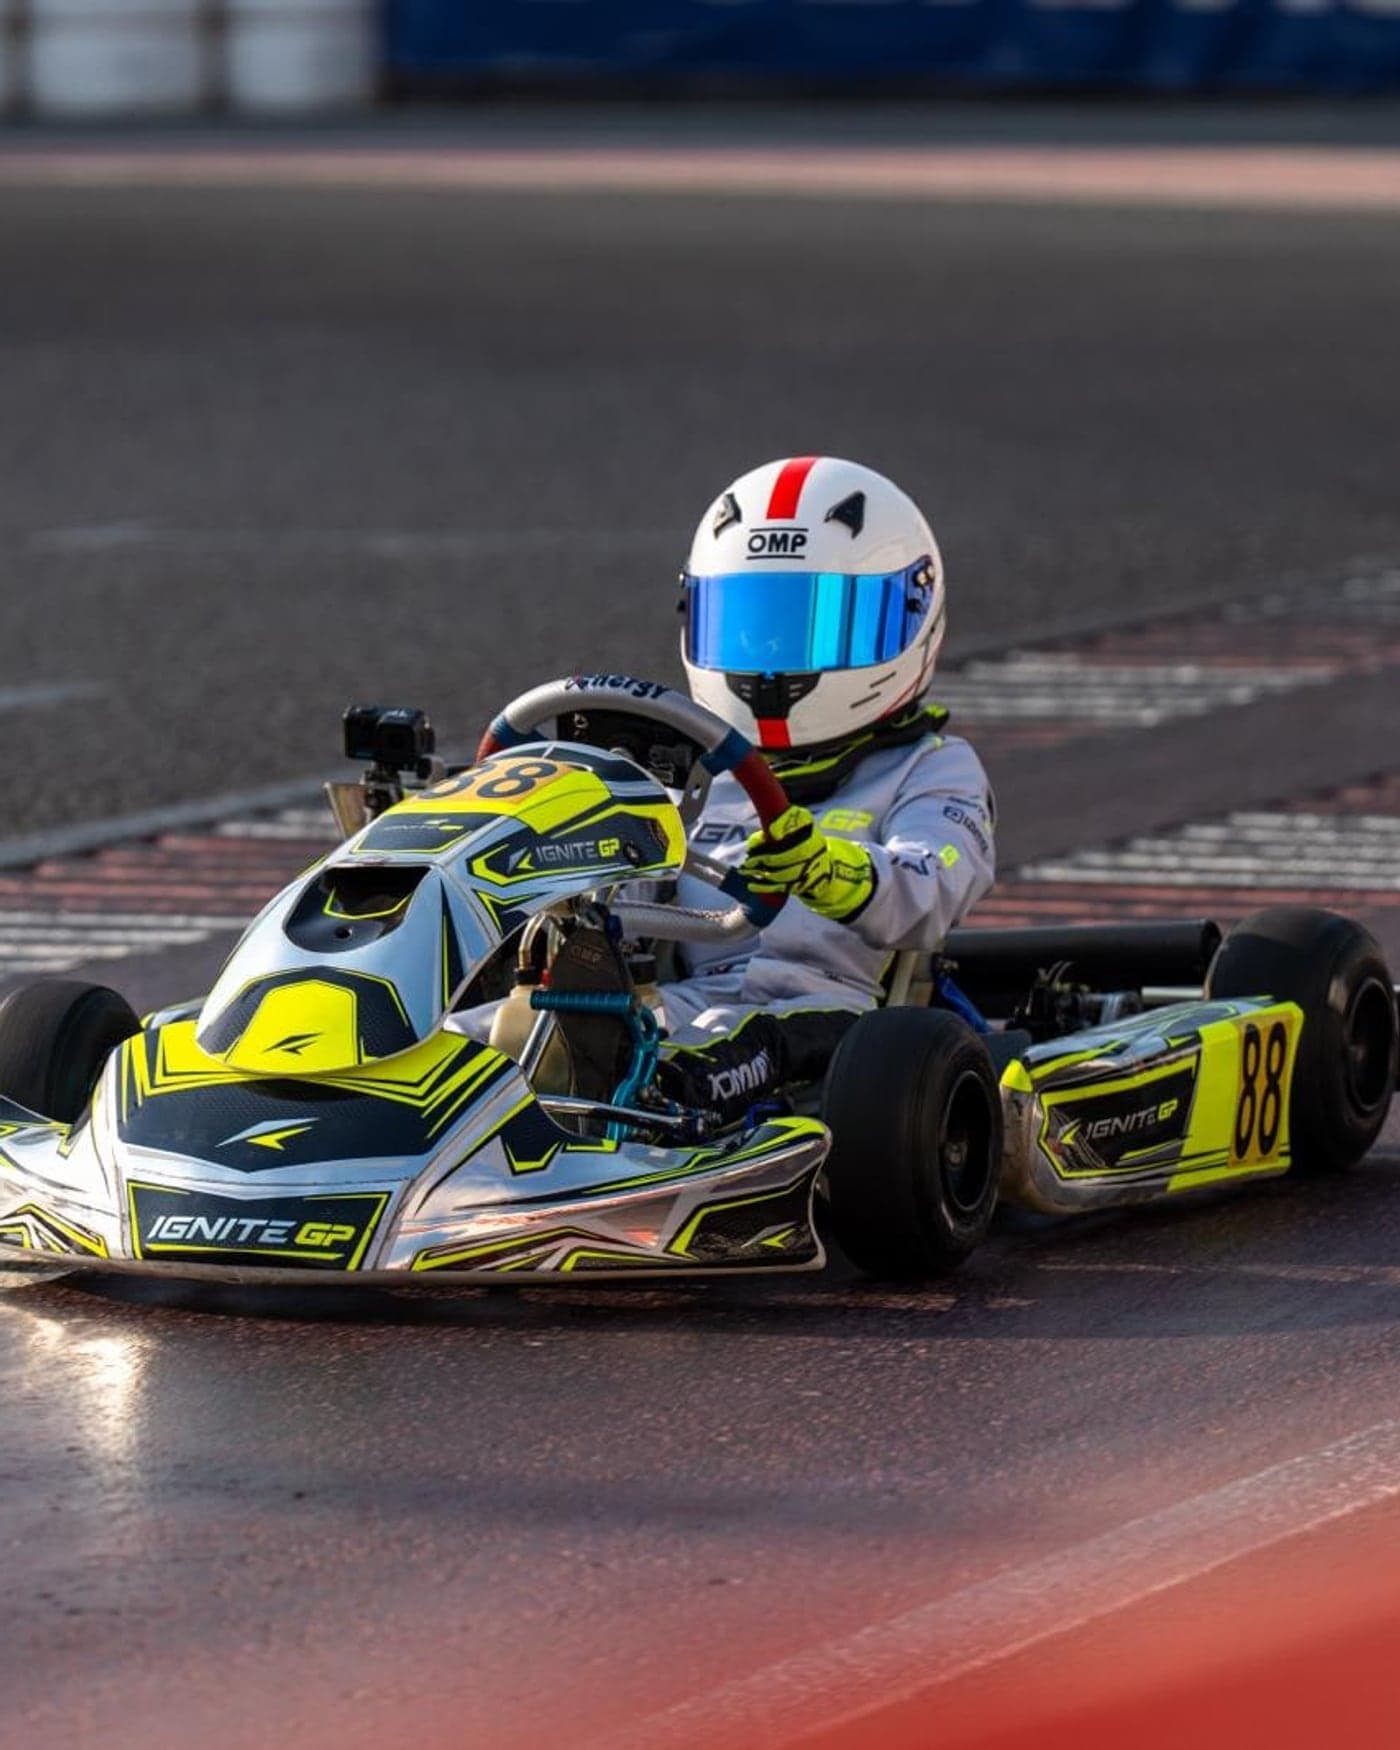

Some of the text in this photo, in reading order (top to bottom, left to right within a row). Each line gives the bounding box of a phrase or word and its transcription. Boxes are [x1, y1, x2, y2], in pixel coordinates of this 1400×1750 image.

[747, 531, 808, 554] OMP
[820, 808, 874, 832] GP
[536, 838, 621, 863] IGNITE GP
[1235, 1021, 1287, 1160] 88
[1085, 1098, 1179, 1140] IGNITE GP
[146, 1215, 357, 1247] IGNITE GP
